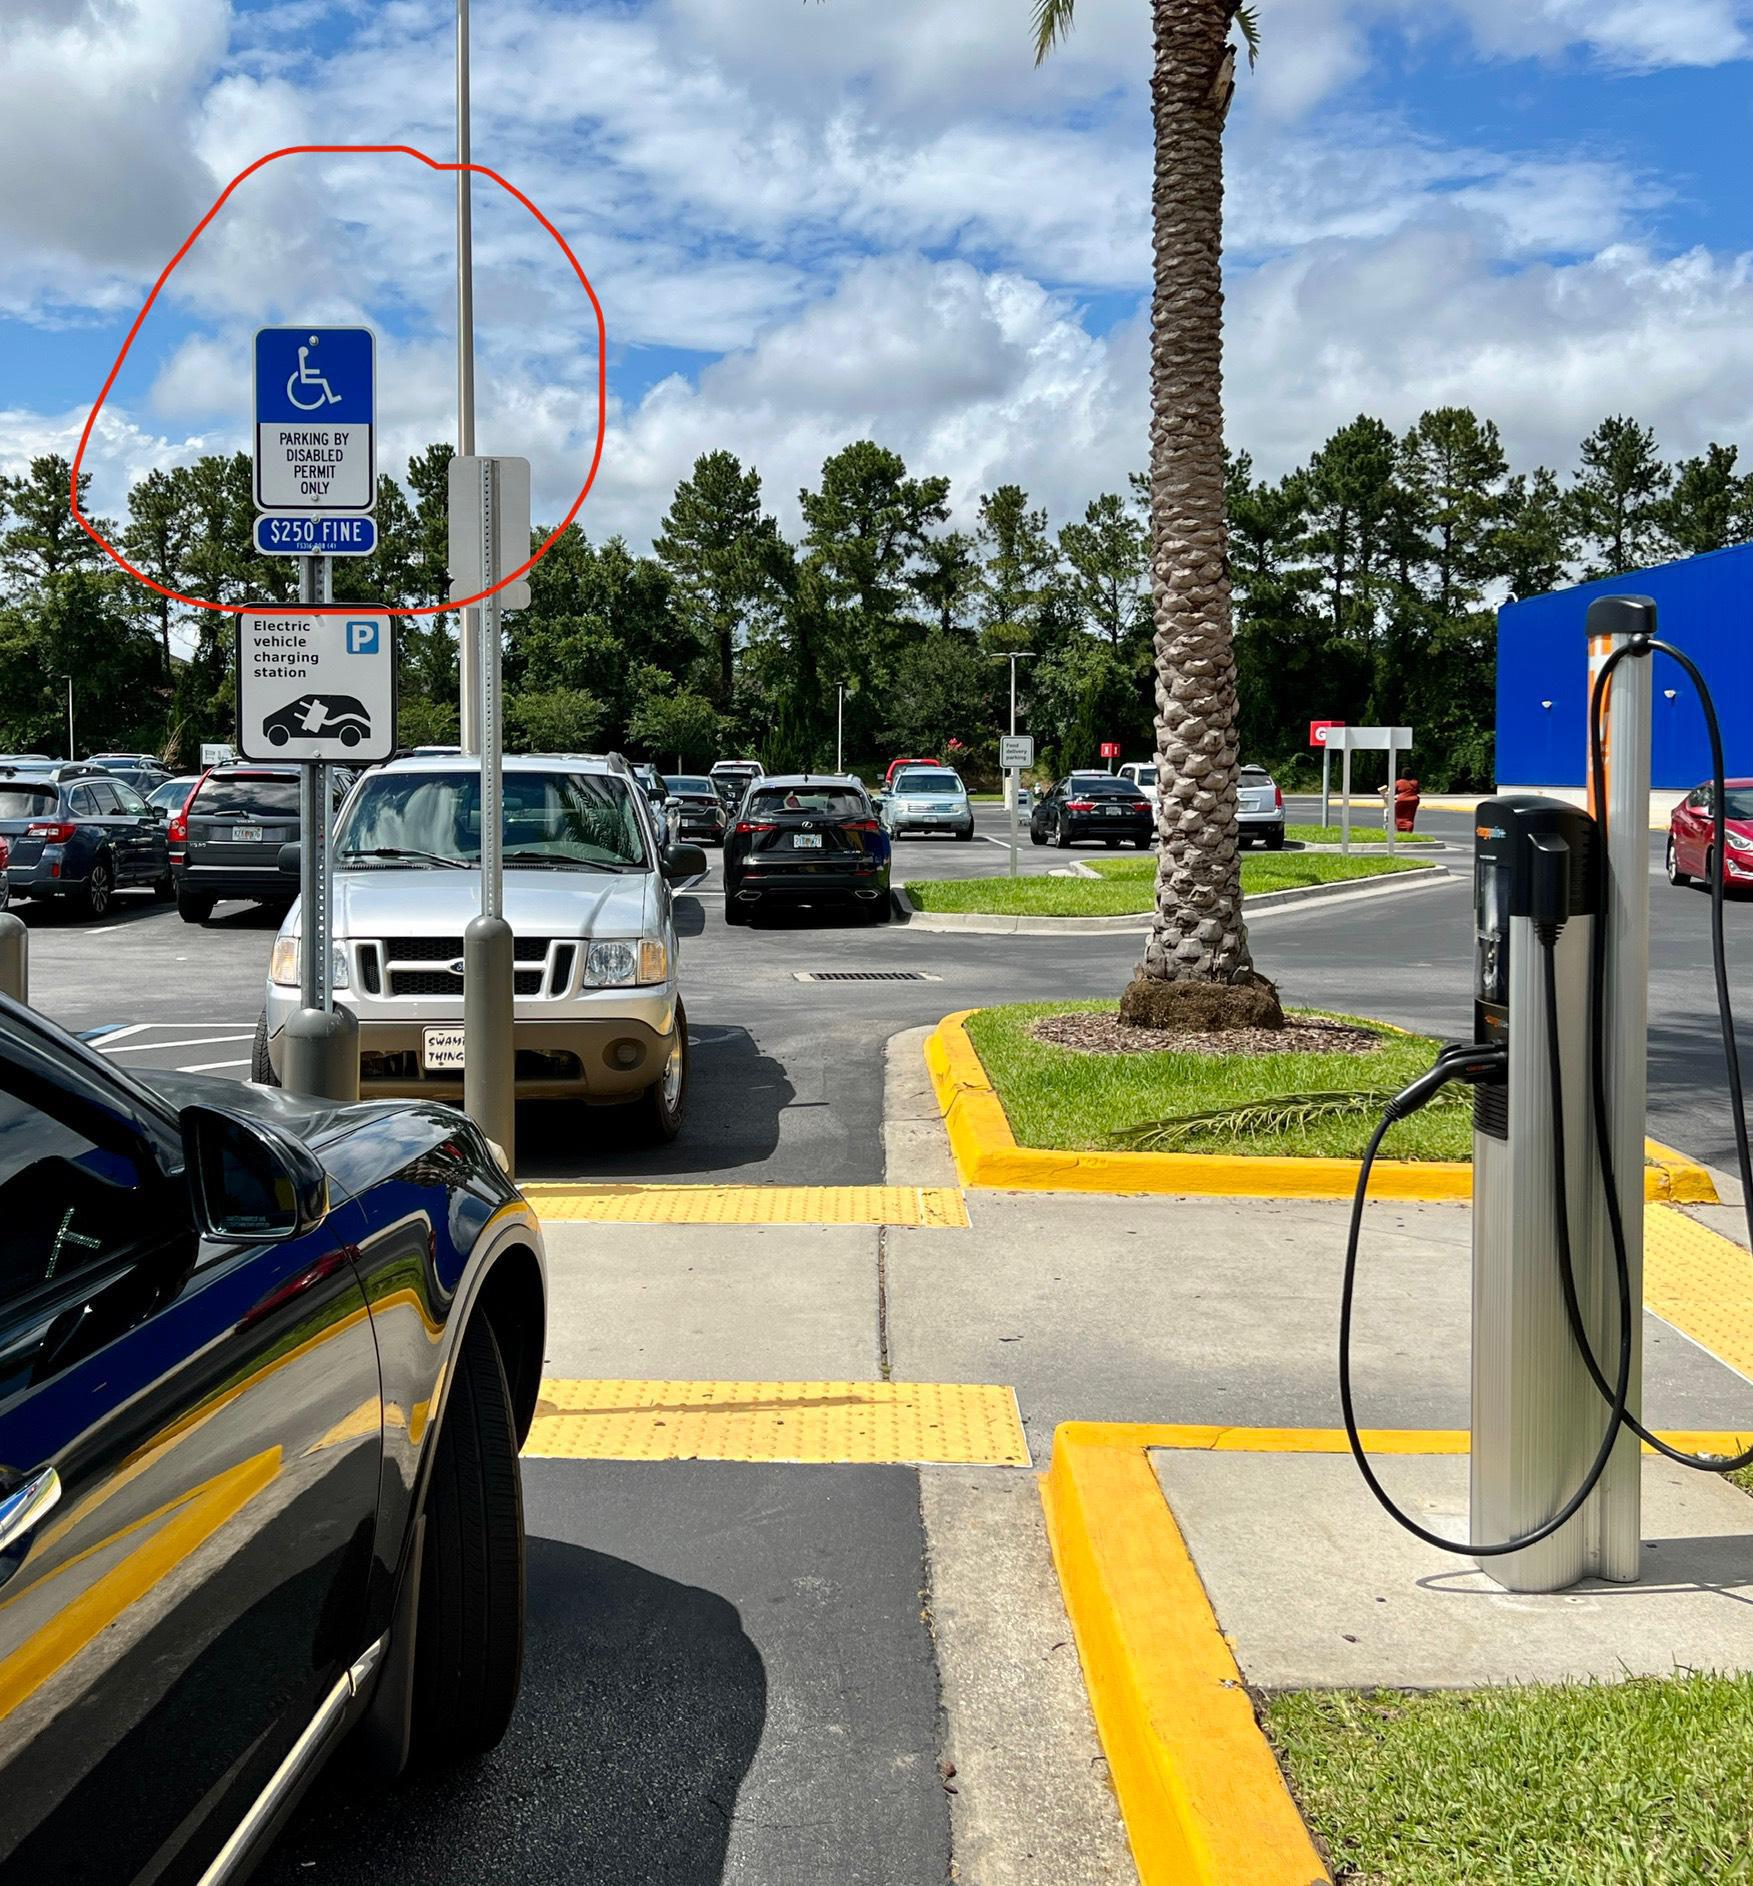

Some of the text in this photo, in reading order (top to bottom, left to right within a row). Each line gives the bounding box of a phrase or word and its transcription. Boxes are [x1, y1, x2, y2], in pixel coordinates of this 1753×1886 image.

[279, 432, 349, 446] PARKING BY
[286, 449, 343, 462] DISABLED
[293, 465, 336, 479] PERMIT
[300, 481, 330, 495] ONLY
[271, 519, 362, 544] $250 FINE
[253, 620, 311, 632] Electric
[253, 635, 307, 648] vehicle
[351, 624, 375, 652] P
[253, 651, 320, 665] charging
[253, 666, 307, 678] station
[428, 1051, 465, 1062] THING
